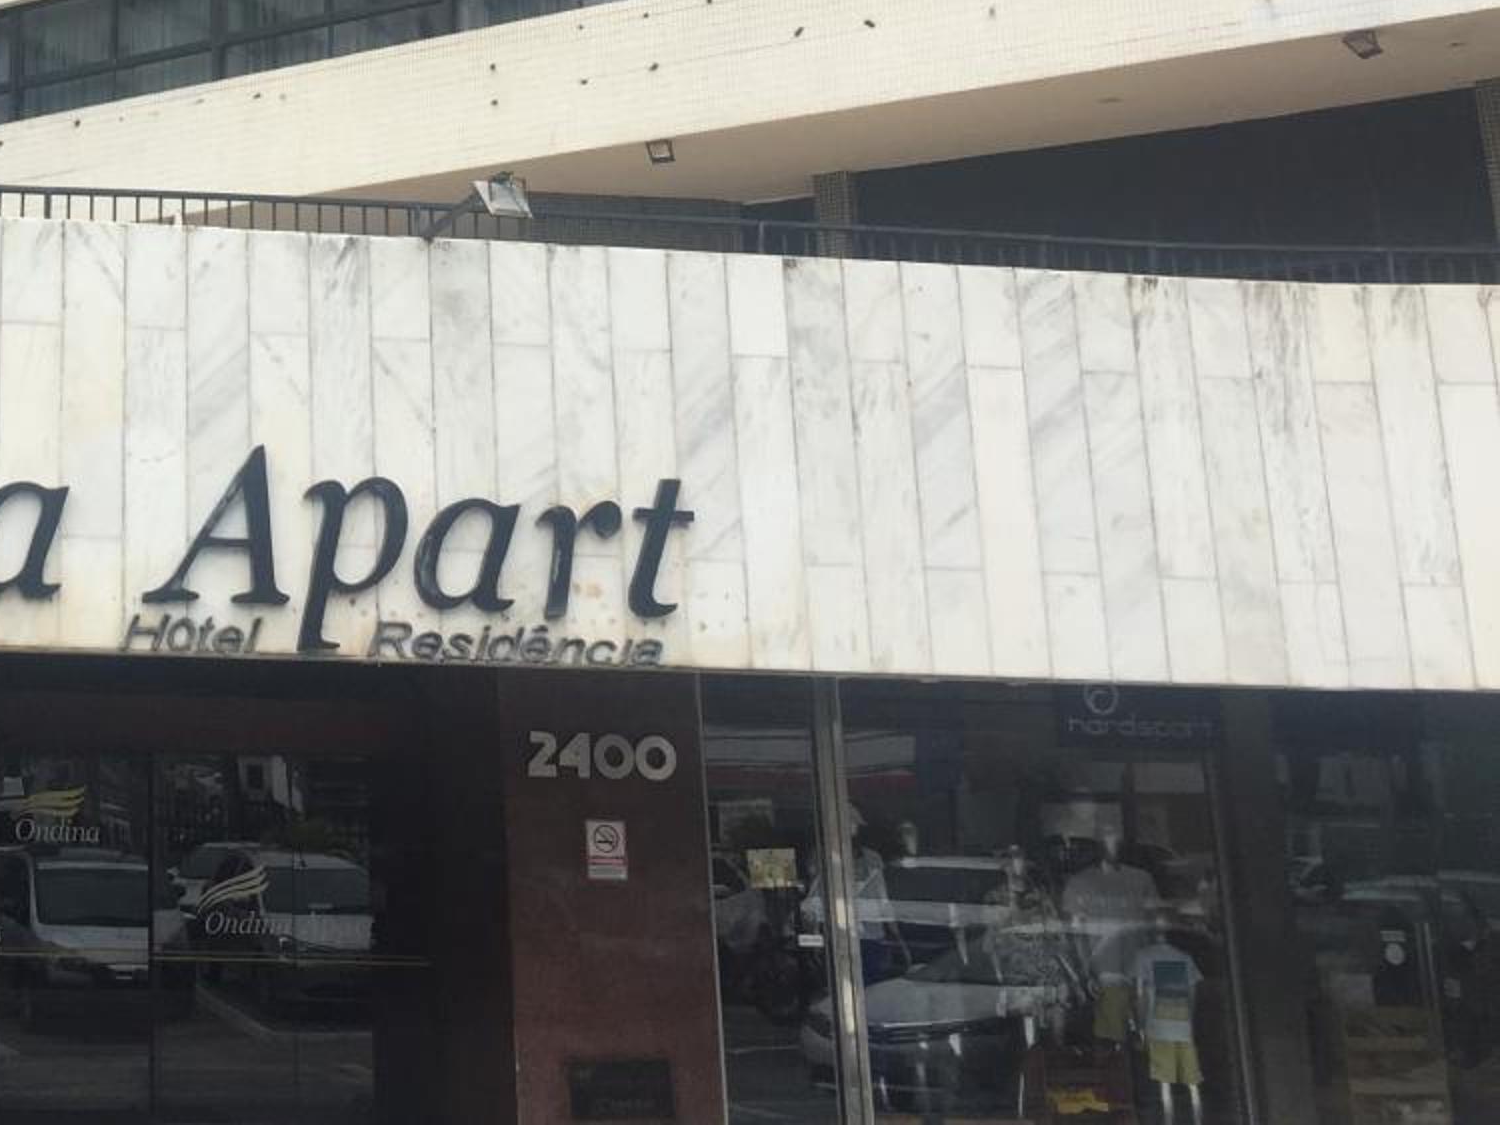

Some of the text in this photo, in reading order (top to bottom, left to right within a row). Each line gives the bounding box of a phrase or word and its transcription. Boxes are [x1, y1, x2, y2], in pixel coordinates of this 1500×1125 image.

[141, 444, 695, 652] Apart
[118, 614, 666, 667] Hotel Residência
[527, 730, 677, 781] 2400
[15, 816, 101, 843] Ondina
